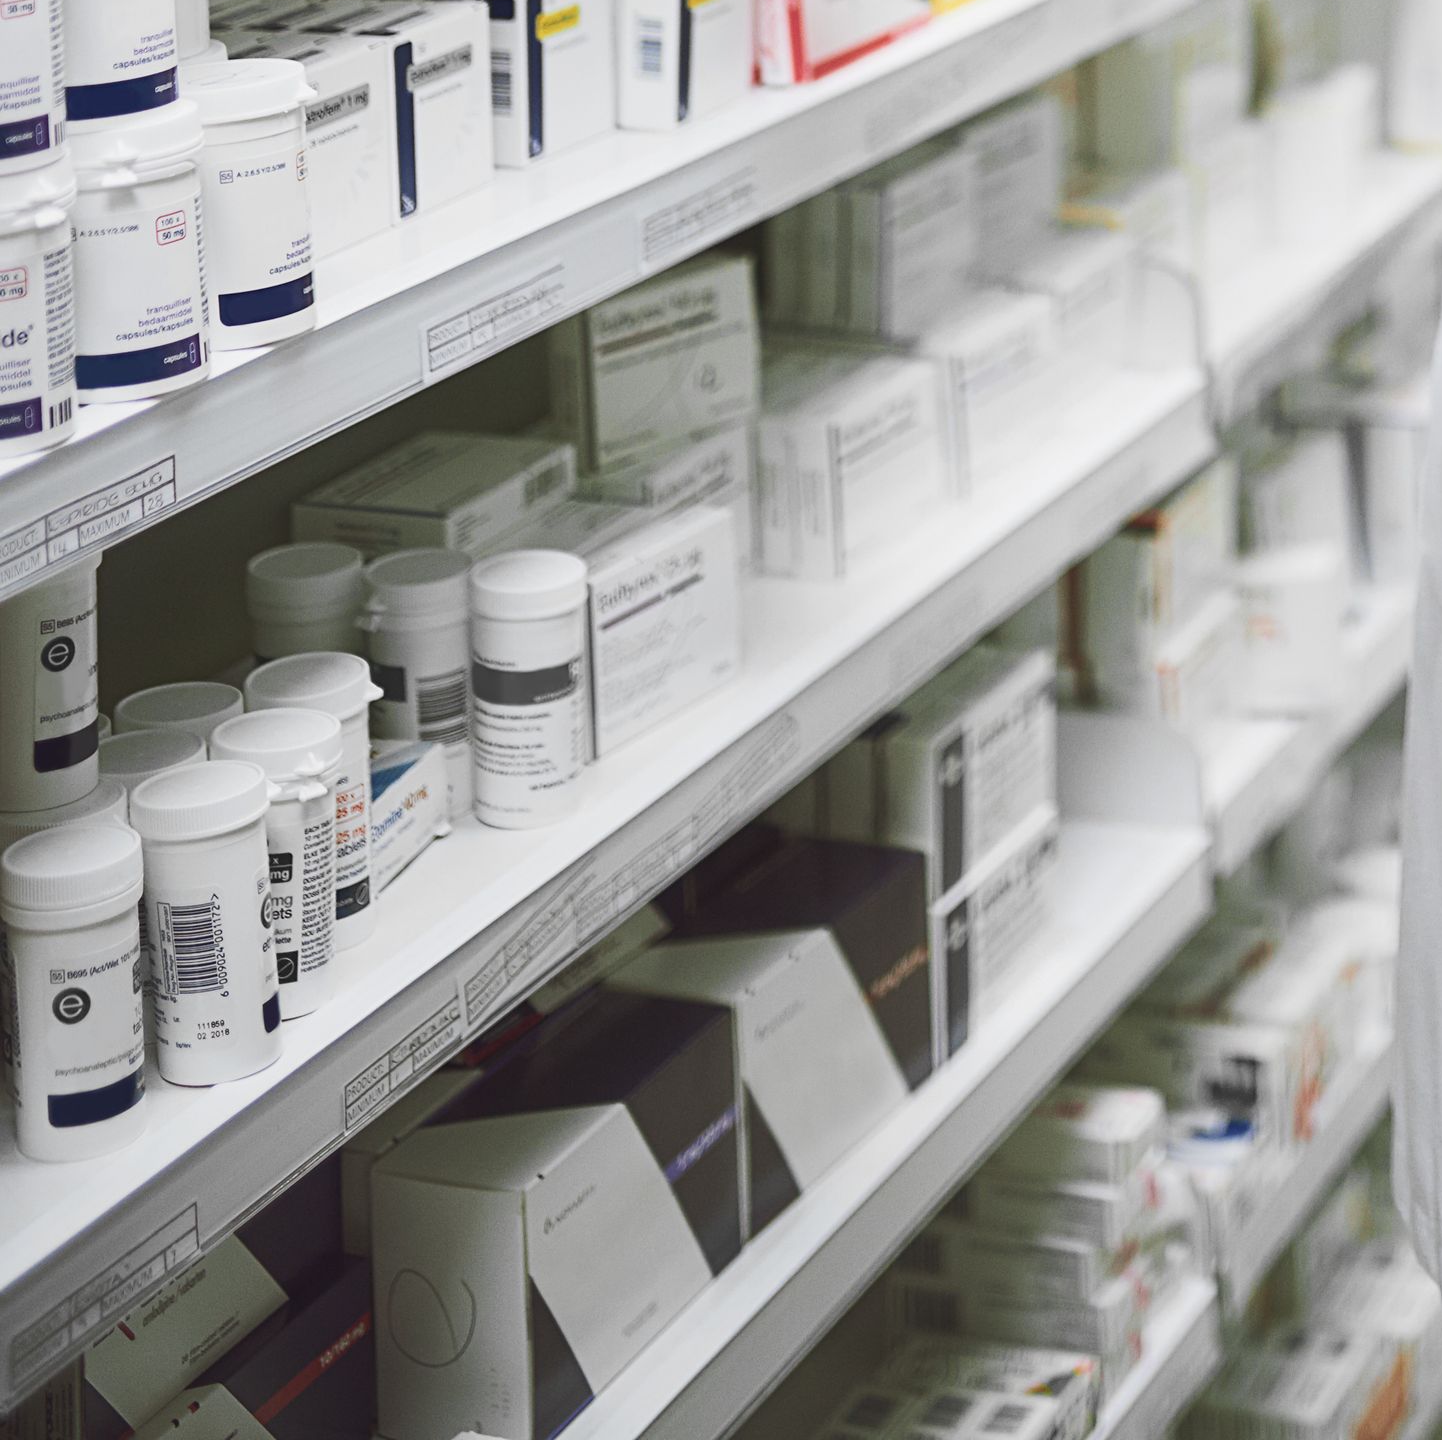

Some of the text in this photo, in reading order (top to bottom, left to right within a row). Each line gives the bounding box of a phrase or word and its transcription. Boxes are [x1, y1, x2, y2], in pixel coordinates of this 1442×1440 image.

[5, 130, 33, 144] capsules
[161, 217, 174, 226] 100
[162, 228, 184, 241] 50 mg
[10, 286, 24, 296] mg
[146, 296, 192, 316] tranquilliser
[138, 307, 193, 328] bedaarmiddel
[116, 318, 193, 342] capsules/kapsules
[164, 350, 188, 364] capsules
[80, 509, 131, 541] MAXIMUM
[270, 870, 290, 881] mg
[271, 895, 293, 908] mg
[272, 908, 292, 921] ets
[211, 903, 230, 998] 6 009024 001172
[197, 1019, 225, 1030] 111859
[197, 1028, 230, 1041] 02 2018
[347, 1082, 386, 1121] MINIMUM
